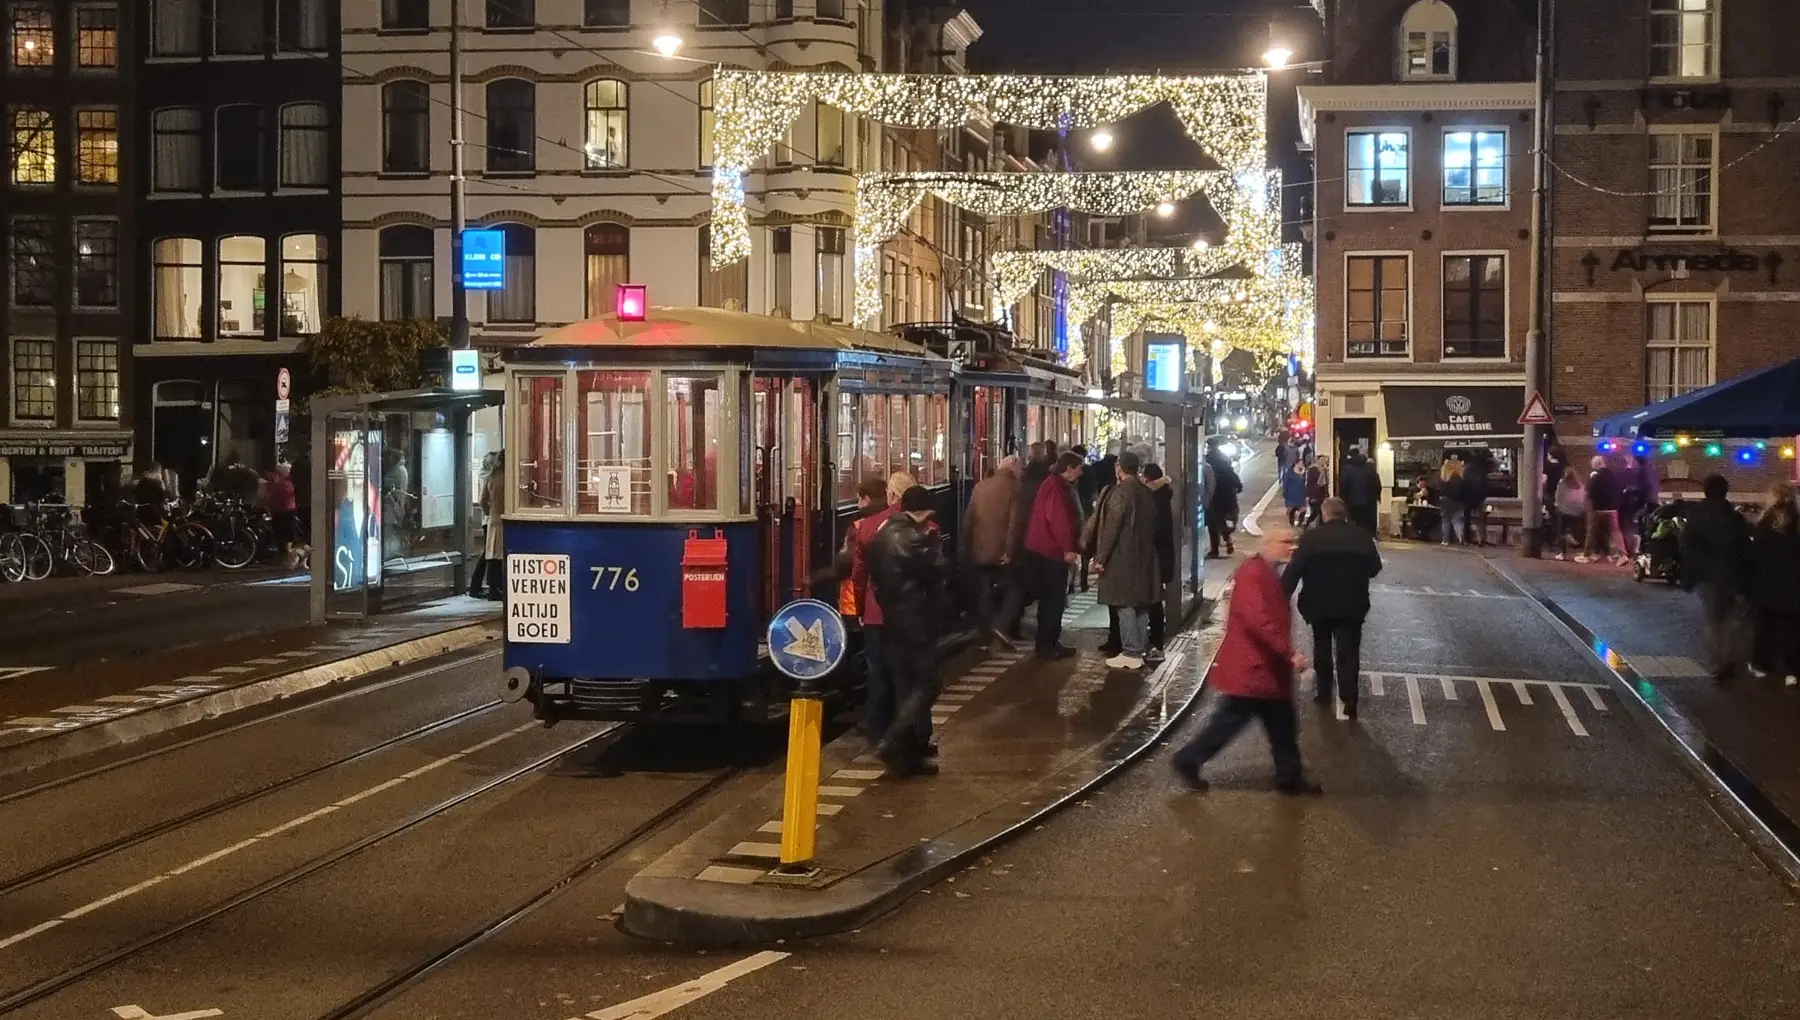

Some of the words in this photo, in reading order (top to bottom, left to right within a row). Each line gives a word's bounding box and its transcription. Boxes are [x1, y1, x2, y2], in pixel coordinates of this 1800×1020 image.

[1610, 248, 1757, 271] Armada
[1434, 423, 1492, 431] BRASSERIE
[1449, 415, 1475, 423] CAFE
[512, 559, 566, 575] HISTOR
[512, 578, 566, 594] VERVEN
[590, 566, 640, 592] 776
[512, 603, 558, 618] ALTIJD
[517, 622, 558, 638] GOED
